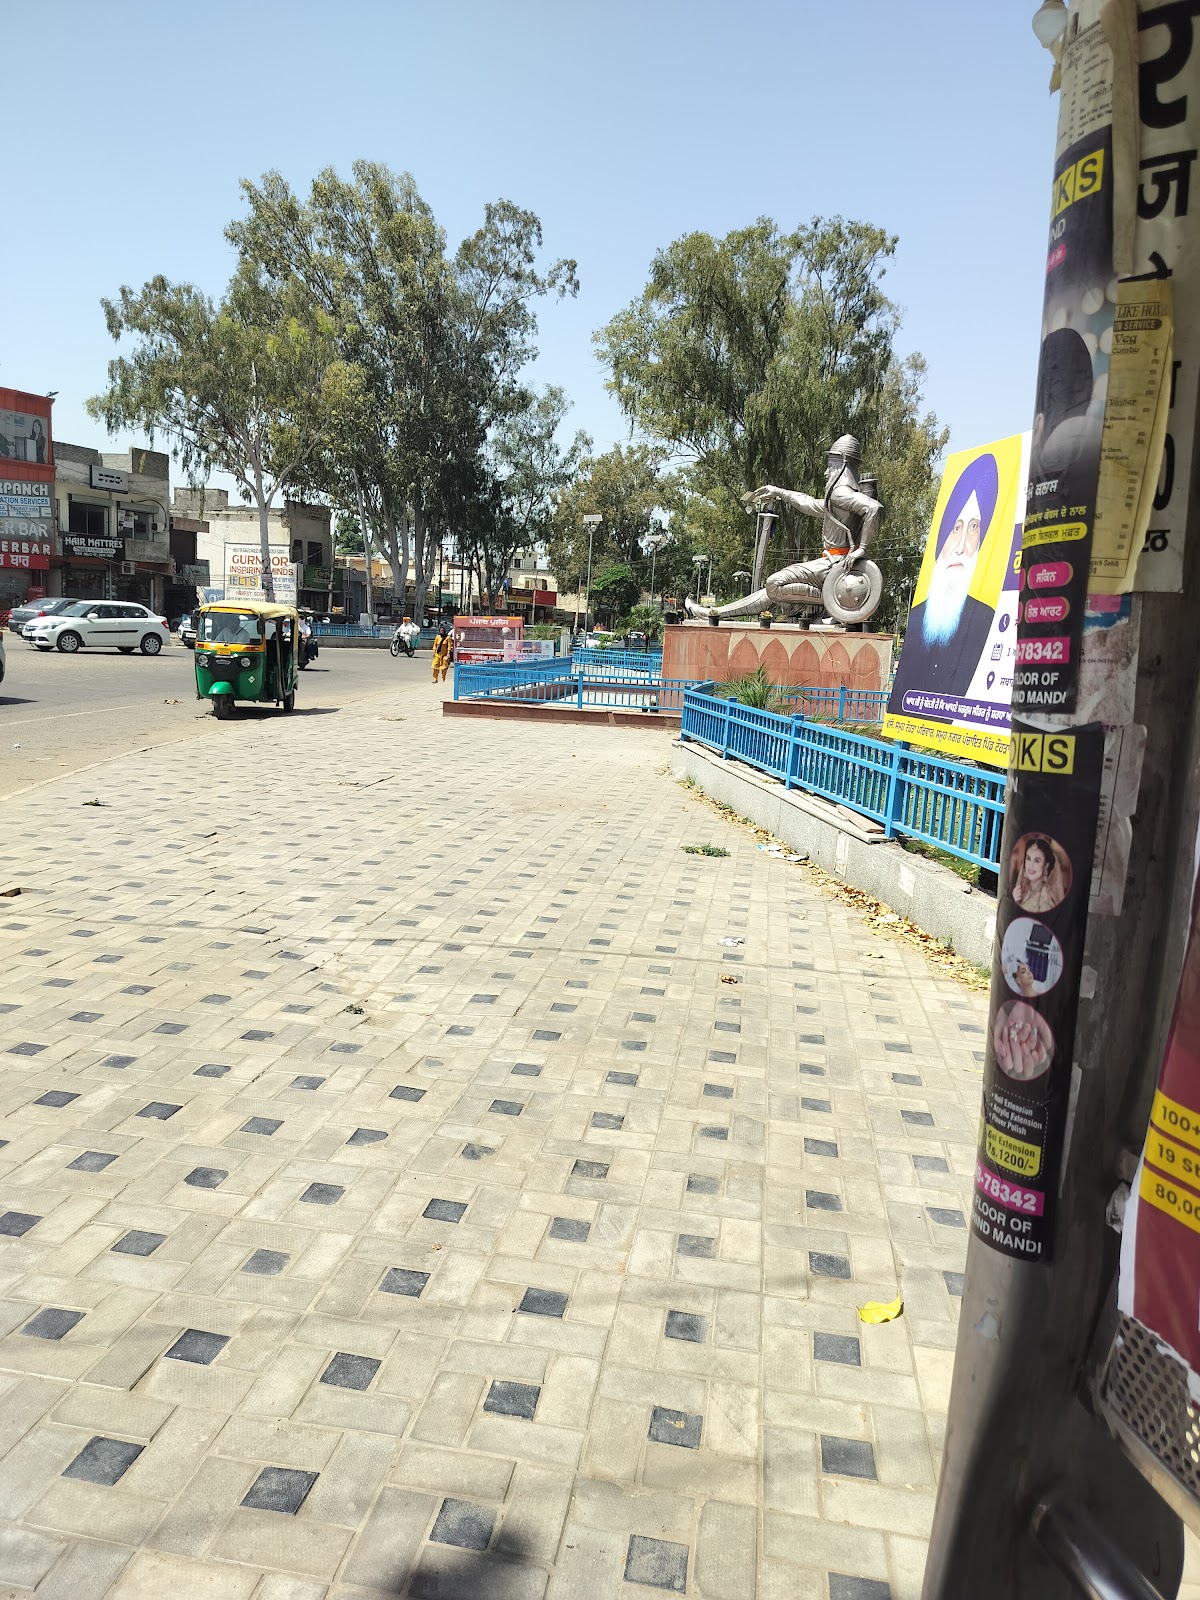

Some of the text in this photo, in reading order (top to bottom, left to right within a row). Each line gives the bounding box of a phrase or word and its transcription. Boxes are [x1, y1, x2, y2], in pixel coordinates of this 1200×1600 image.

[1124, 320, 1156, 330] SERVICE
[1114, 334, 1138, 345] Veg
[1069, 506, 1087, 516] ਨਾਲ
[64, 536, 123, 549] HAIR MATTRES
[229, 575, 257, 586] IELTS
[1040, 605, 1062, 617] ਆਰਟ
[1041, 672, 1059, 686] OF
[1027, 690, 1066, 704] MANDI
[1004, 1099, 1034, 1116] Extension
[1010, 1111, 1042, 1130] Extension
[1007, 1120, 1027, 1136] Polish
[988, 1130, 1036, 1158] Gel Extension
[1158, 1143, 1175, 1164] 19
[975, 1196, 1032, 1235] FLOOR OF
[992, 1230, 1042, 1254] MANDI
